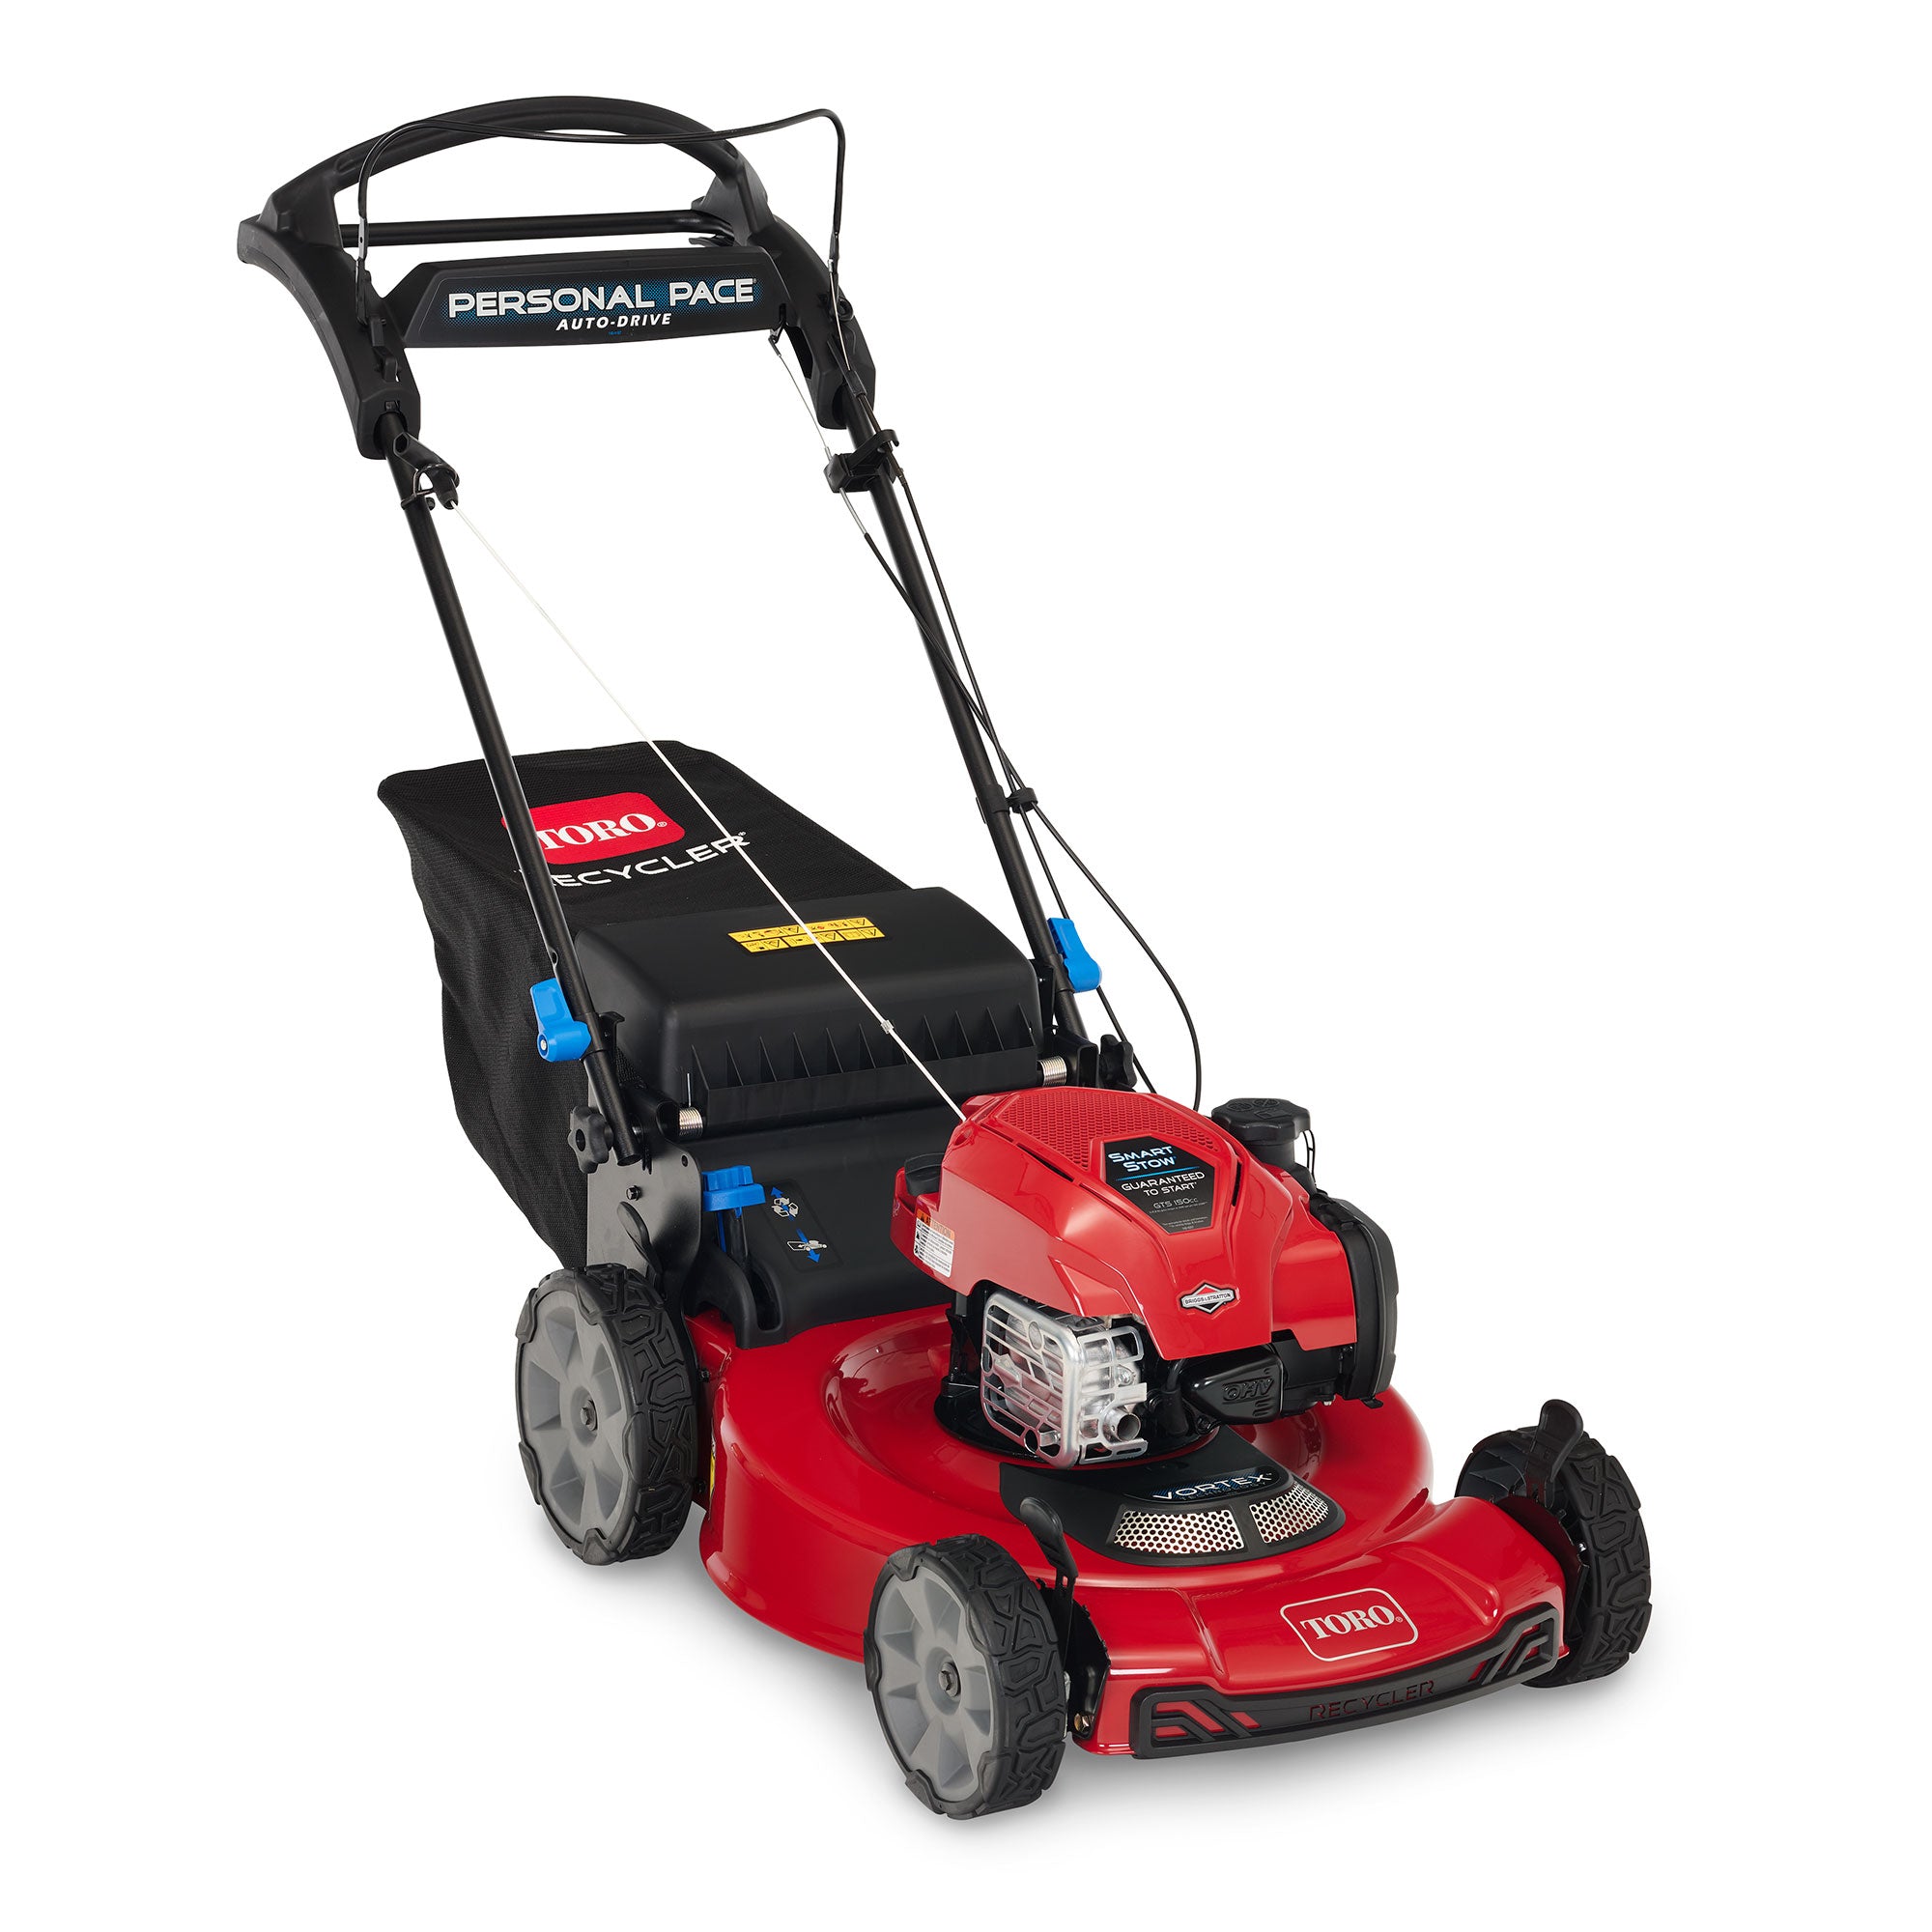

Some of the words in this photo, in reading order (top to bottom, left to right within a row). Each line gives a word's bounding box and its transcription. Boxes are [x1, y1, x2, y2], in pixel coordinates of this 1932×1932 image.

[448, 284, 655, 319] PERSONAL
[668, 277, 754, 307] PACE
[555, 312, 672, 331] AUTO-DRIVE
[537, 812, 657, 850] TORO
[513, 834, 751, 888] ECYCLER
[1108, 1146, 1174, 1163] SMART
[1122, 1156, 1176, 1173] STOW
[1122, 1172, 1206, 1191] GUARANTEED
[1153, 1200, 1173, 1208] GTS
[1222, 1377, 1274, 1402] OHV
[1152, 1473, 1272, 1500] VORTEX
[1299, 1605, 1395, 1640] TORO
[1309, 1680, 1435, 1721] RECYCLER
